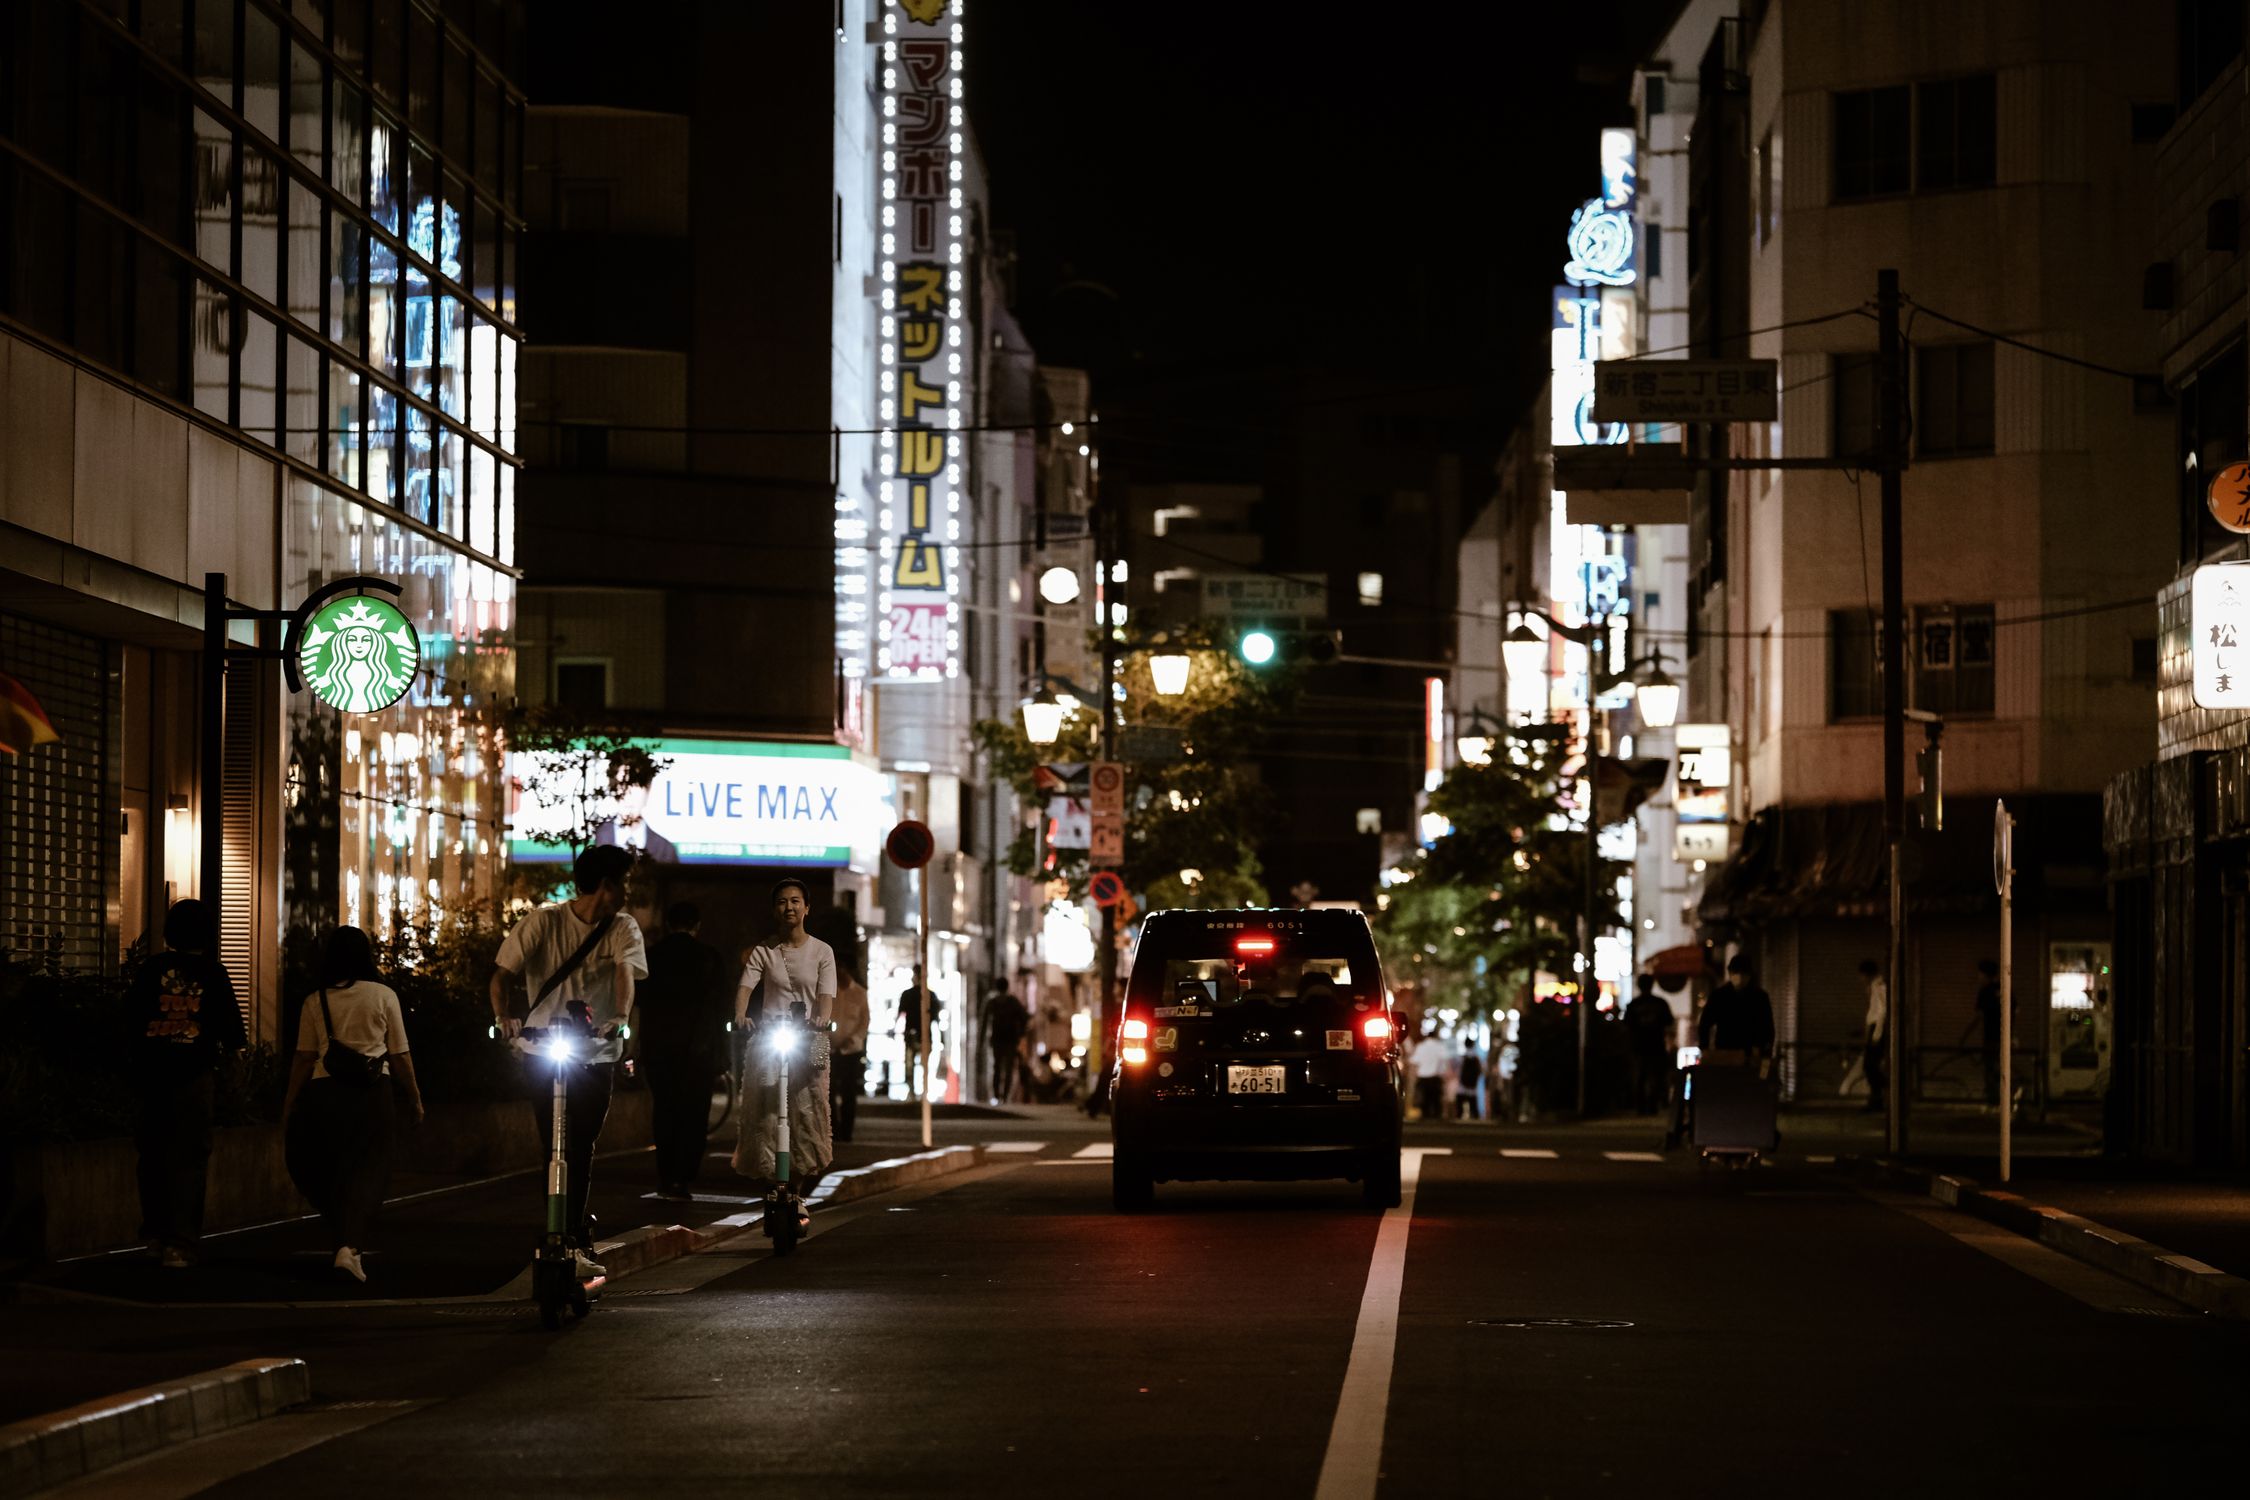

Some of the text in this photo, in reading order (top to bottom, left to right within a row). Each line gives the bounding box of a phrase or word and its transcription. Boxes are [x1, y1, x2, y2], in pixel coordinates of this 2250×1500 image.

[1604, 370, 1769, 397] 新宿二丁目東
[889, 640, 948, 663] OPEN
[2209, 623, 2238, 693] 松しま
[757, 784, 838, 822] MAX
[1266, 921, 1304, 929] 6051
[1240, 1077, 1280, 1092] 60-51
